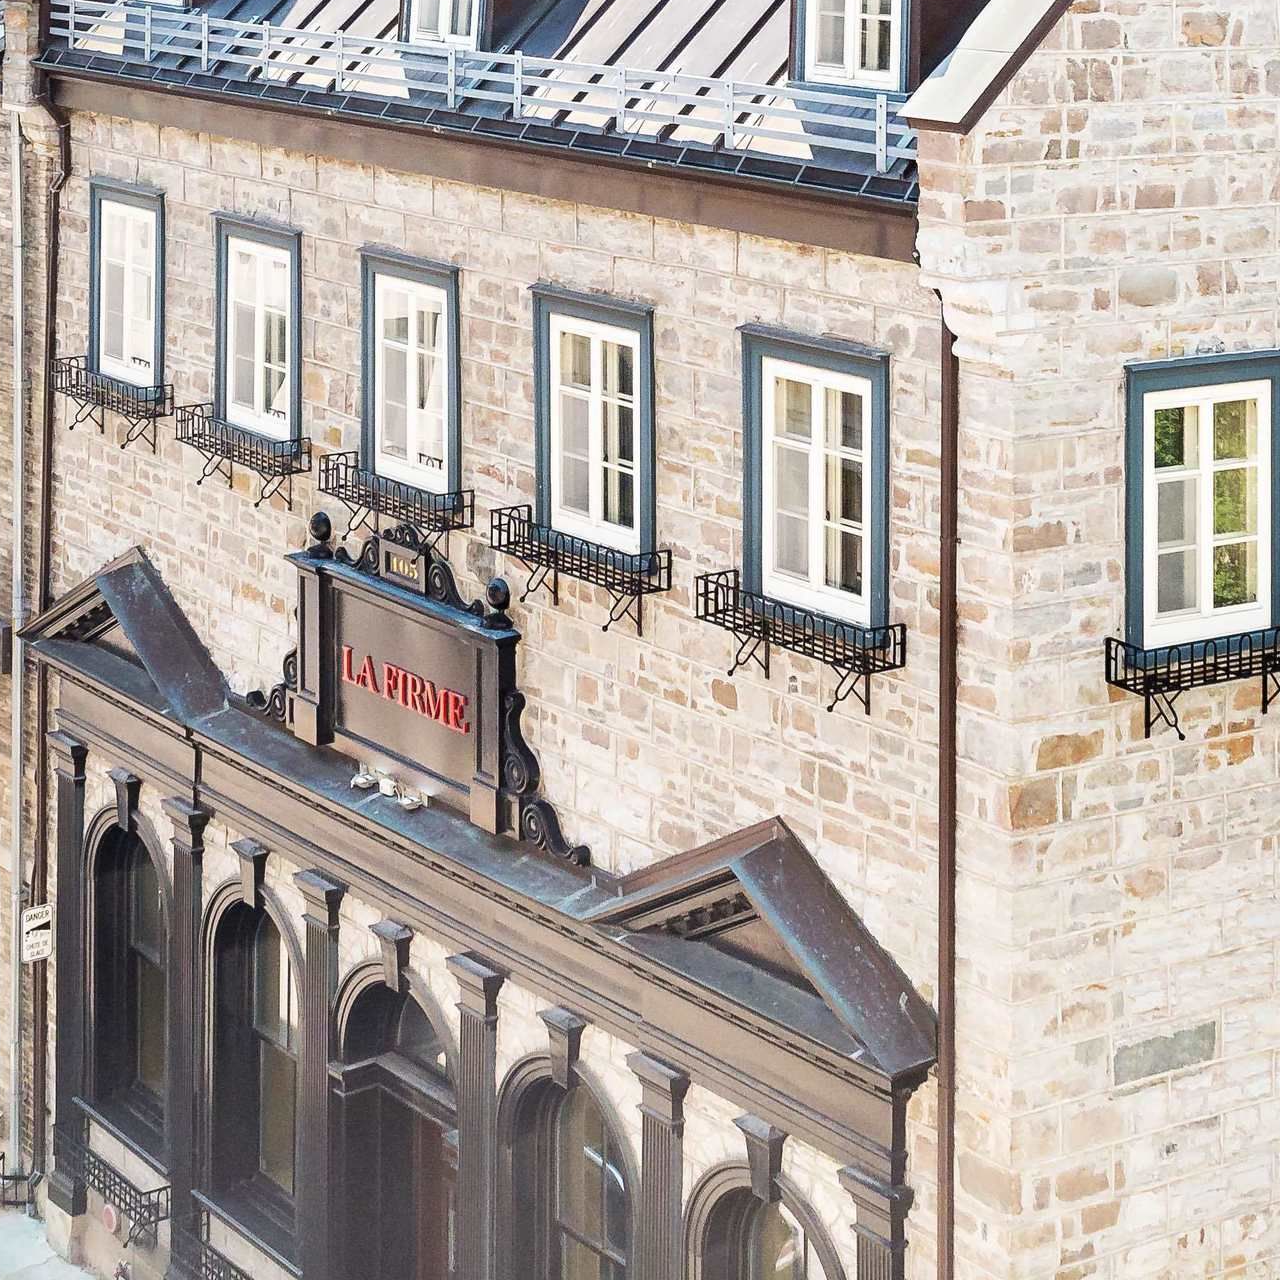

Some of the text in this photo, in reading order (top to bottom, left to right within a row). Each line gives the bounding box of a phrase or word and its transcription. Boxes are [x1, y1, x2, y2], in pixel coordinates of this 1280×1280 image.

[391, 554, 419, 579] 105
[341, 644, 470, 736] LA FIRME
[25, 910, 50, 922] DANGER
